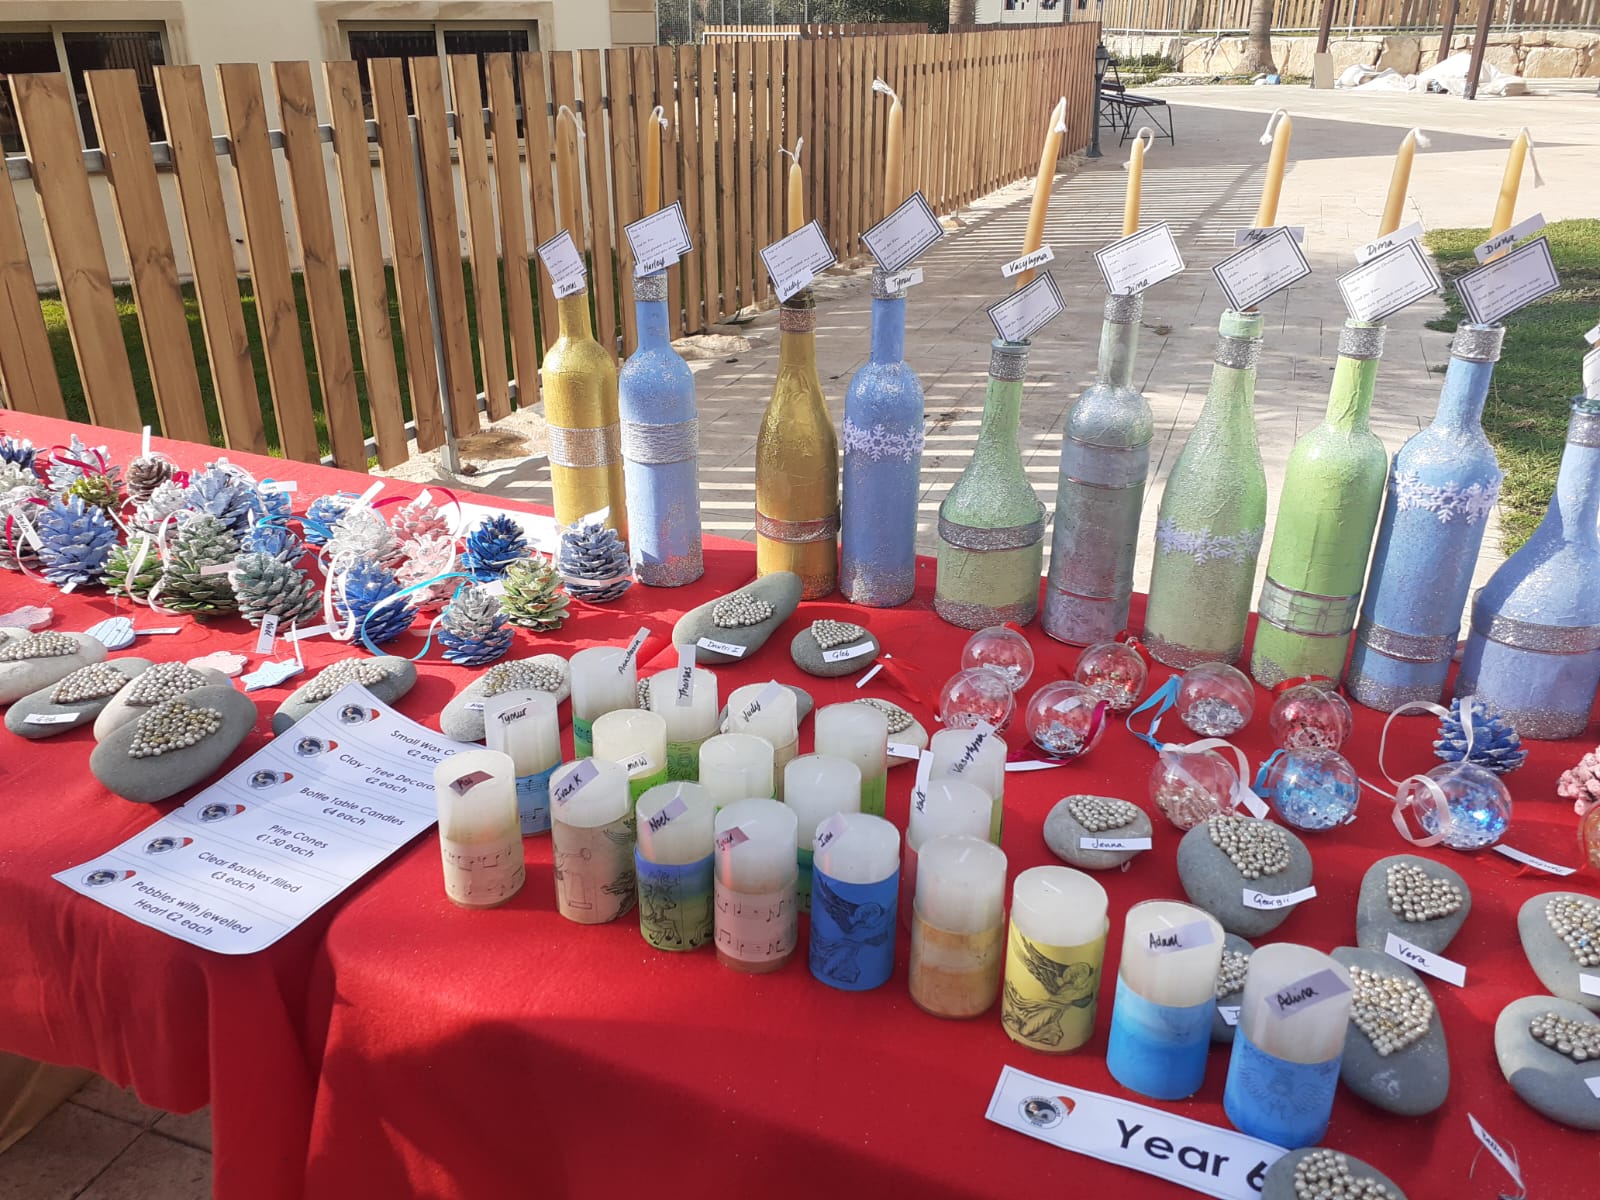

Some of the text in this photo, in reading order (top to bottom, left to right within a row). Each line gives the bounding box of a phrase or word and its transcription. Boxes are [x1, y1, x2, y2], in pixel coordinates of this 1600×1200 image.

[390, 730, 421, 746] Small
[420, 739, 442, 753] Wax
[407, 749, 442, 764] €2 eac
[339, 754, 364, 769] Clay
[371, 767, 394, 778] Tree
[395, 774, 437, 791] Decora
[379, 781, 408, 794] each
[300, 787, 406, 826] Bottle Table Candles
[322, 807, 366, 826] €4 each
[256, 834, 314, 858] €1.50 each
[268, 824, 329, 849] Pine Cones
[198, 852, 303, 893] Clear Baubles filled
[210, 871, 256, 891] €3 each
[131, 881, 253, 934] Pebbles with jewelled
[133, 899, 214, 936] Heart €2 each
[1397, 943, 1430, 968] Vera
[1116, 1118, 1268, 1193] Year 6
